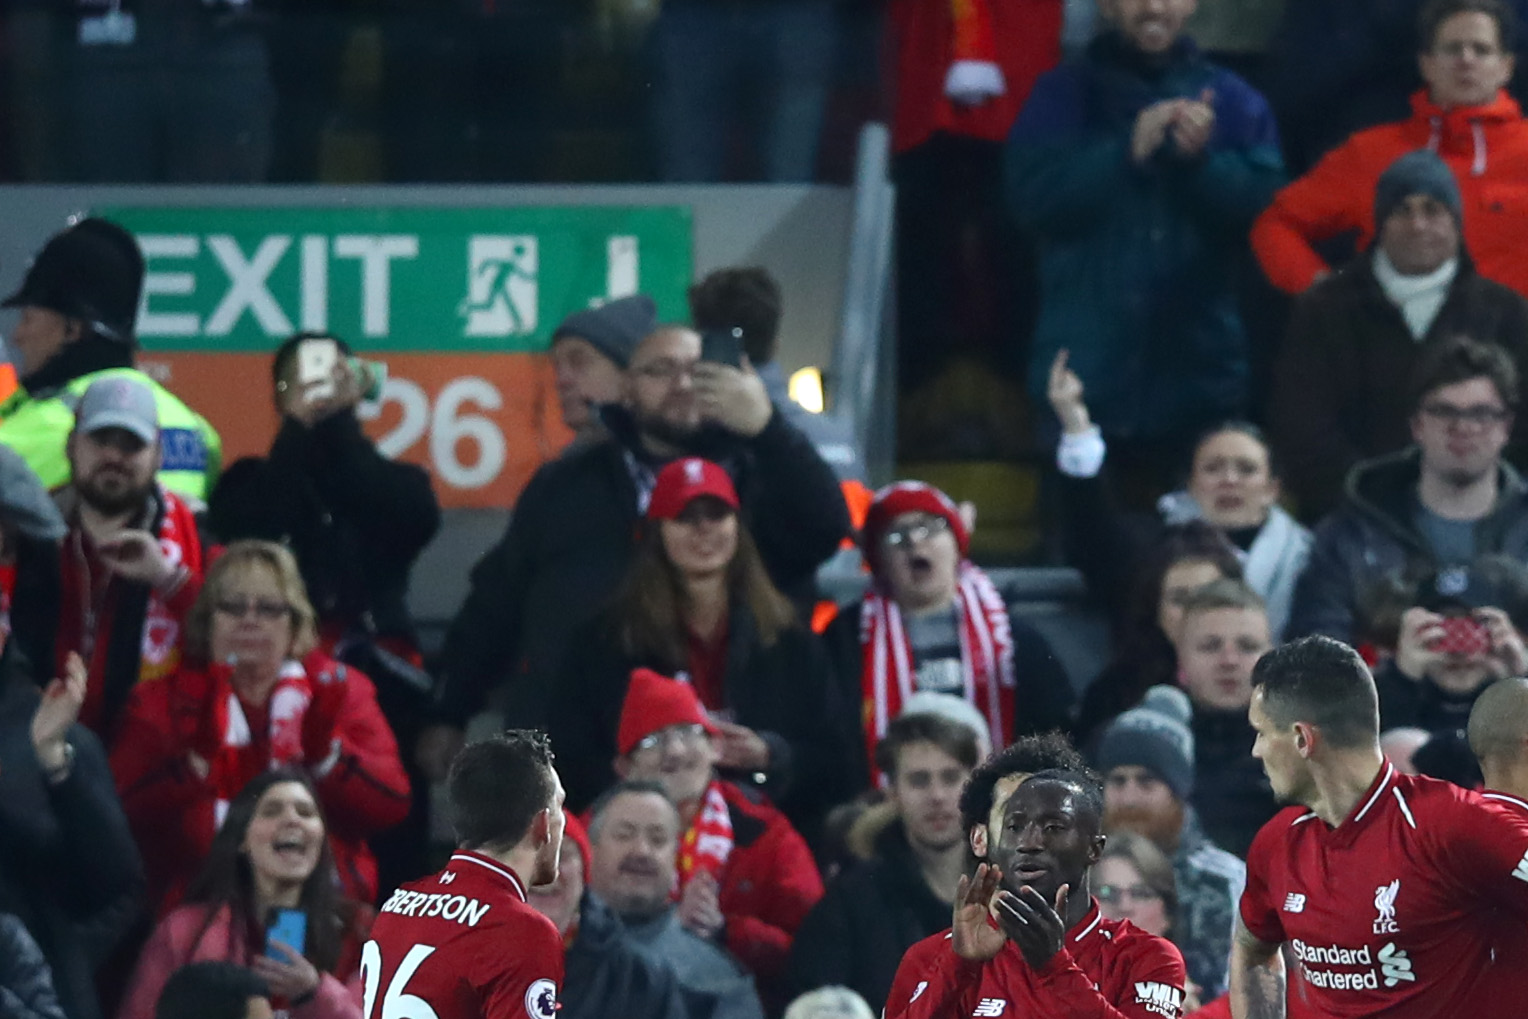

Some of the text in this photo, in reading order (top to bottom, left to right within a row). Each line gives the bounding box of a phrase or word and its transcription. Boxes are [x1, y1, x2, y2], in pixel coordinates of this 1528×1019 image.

[134, 234, 419, 337] EXIT
[380, 887, 491, 927] BERTSON
[1292, 938, 1372, 965] Standard
